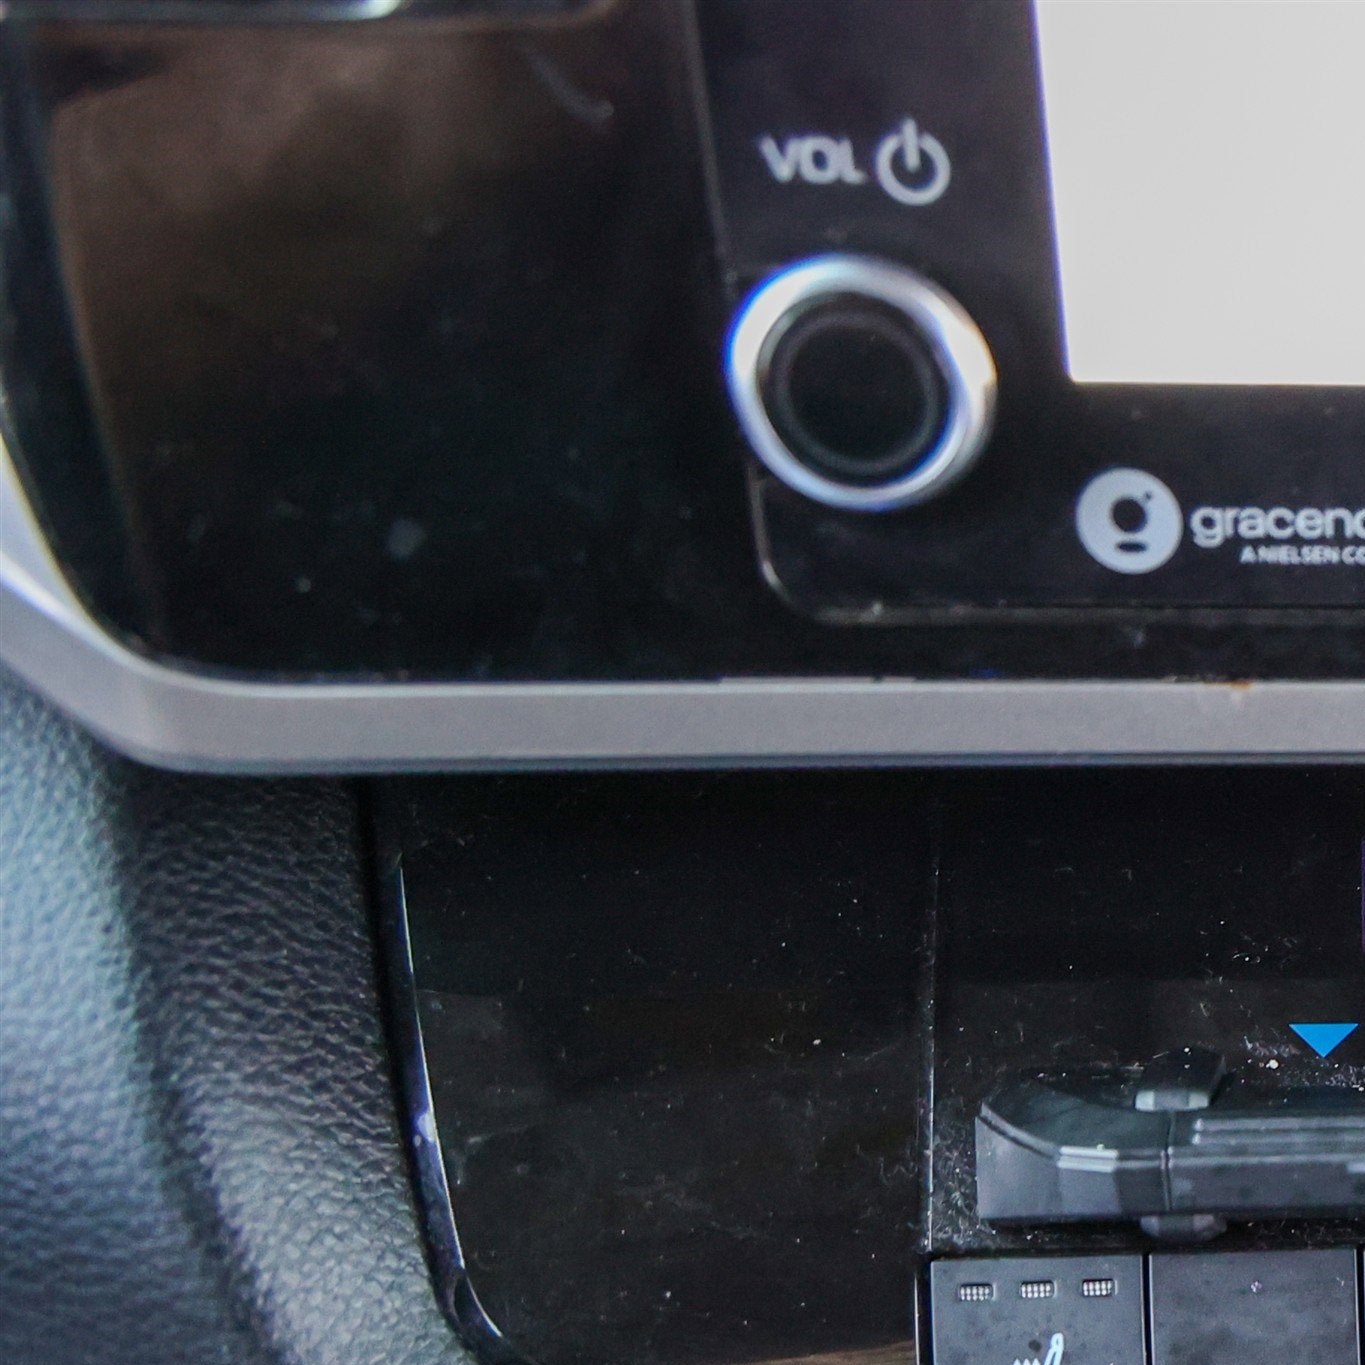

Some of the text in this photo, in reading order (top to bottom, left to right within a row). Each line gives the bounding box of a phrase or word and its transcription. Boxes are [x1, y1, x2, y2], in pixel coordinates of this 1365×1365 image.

[761, 136, 863, 185] VOL
[1240, 545, 1257, 564] A
[1258, 545, 1340, 564] NIELSEN
